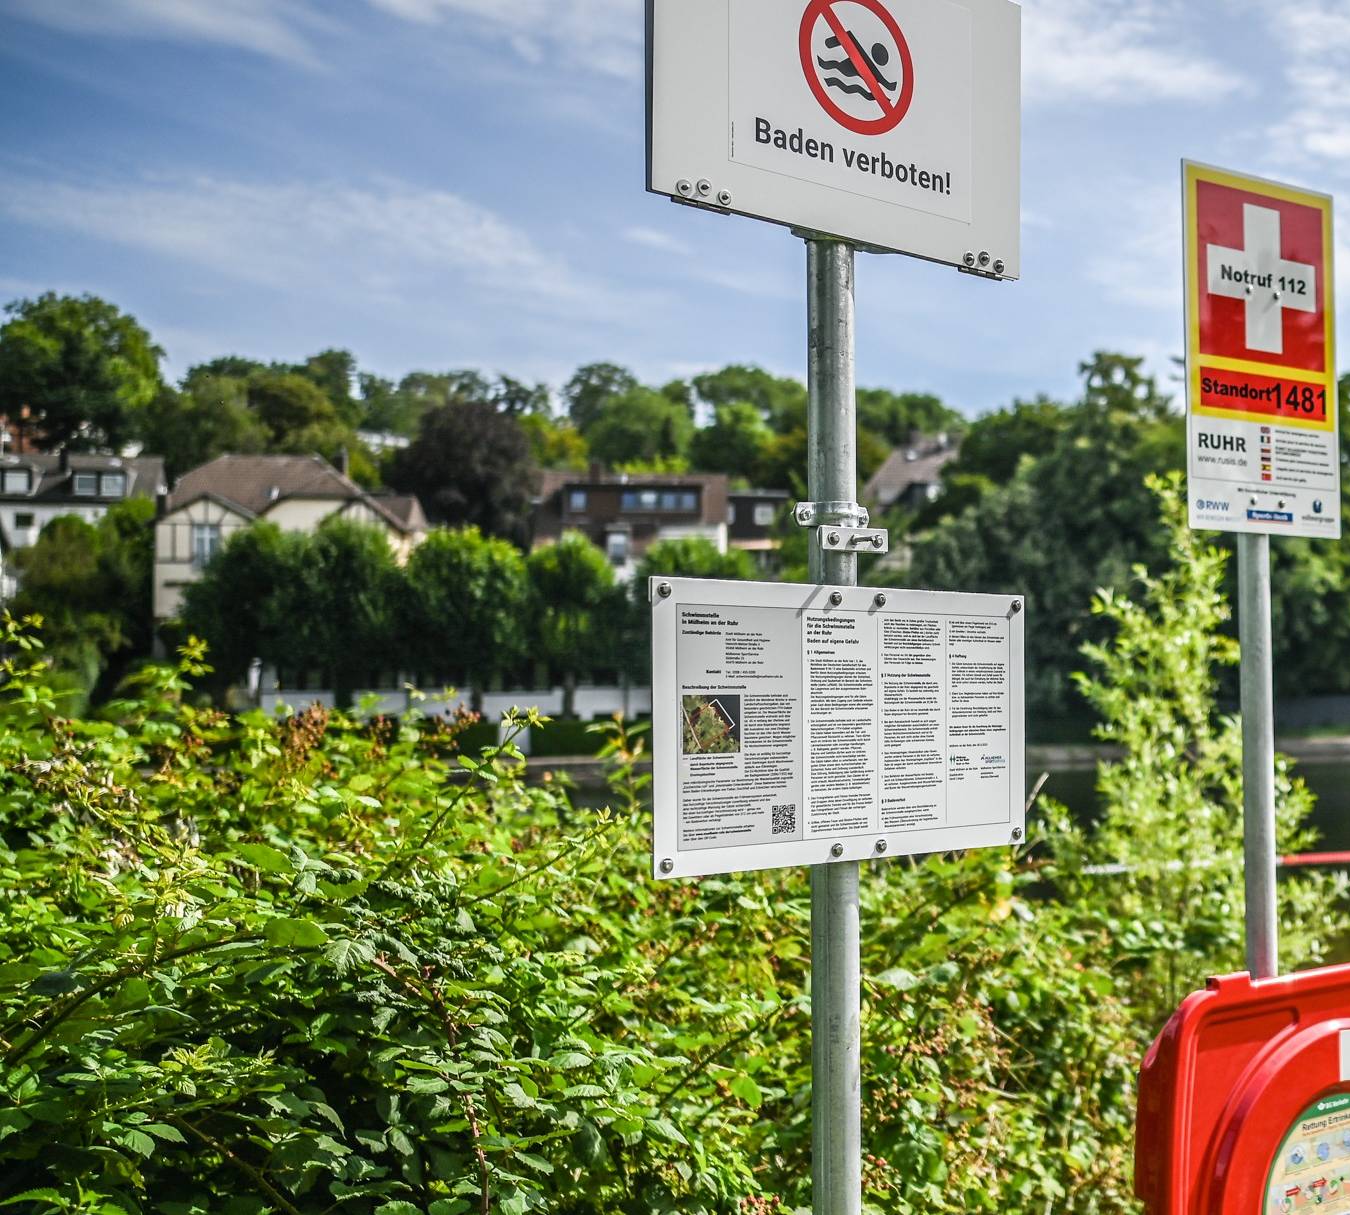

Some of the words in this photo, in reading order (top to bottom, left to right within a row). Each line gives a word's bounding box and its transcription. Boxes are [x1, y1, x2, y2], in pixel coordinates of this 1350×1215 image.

[755, 116, 834, 164] Baden
[842, 147, 952, 196] verboten!
[1221, 264, 1273, 289] Notruf
[1278, 276, 1306, 295] 112
[1201, 377, 1273, 402] Standort
[1271, 382, 1326, 416] 1481
[1198, 432, 1247, 453] RUHR
[1197, 455, 1248, 467] www.rusis.de
[681, 611, 720, 619] Schwimmstelle
[806, 616, 856, 624] Nutzungsbedingungen
[1302, 1120, 1328, 1131] Rettung
